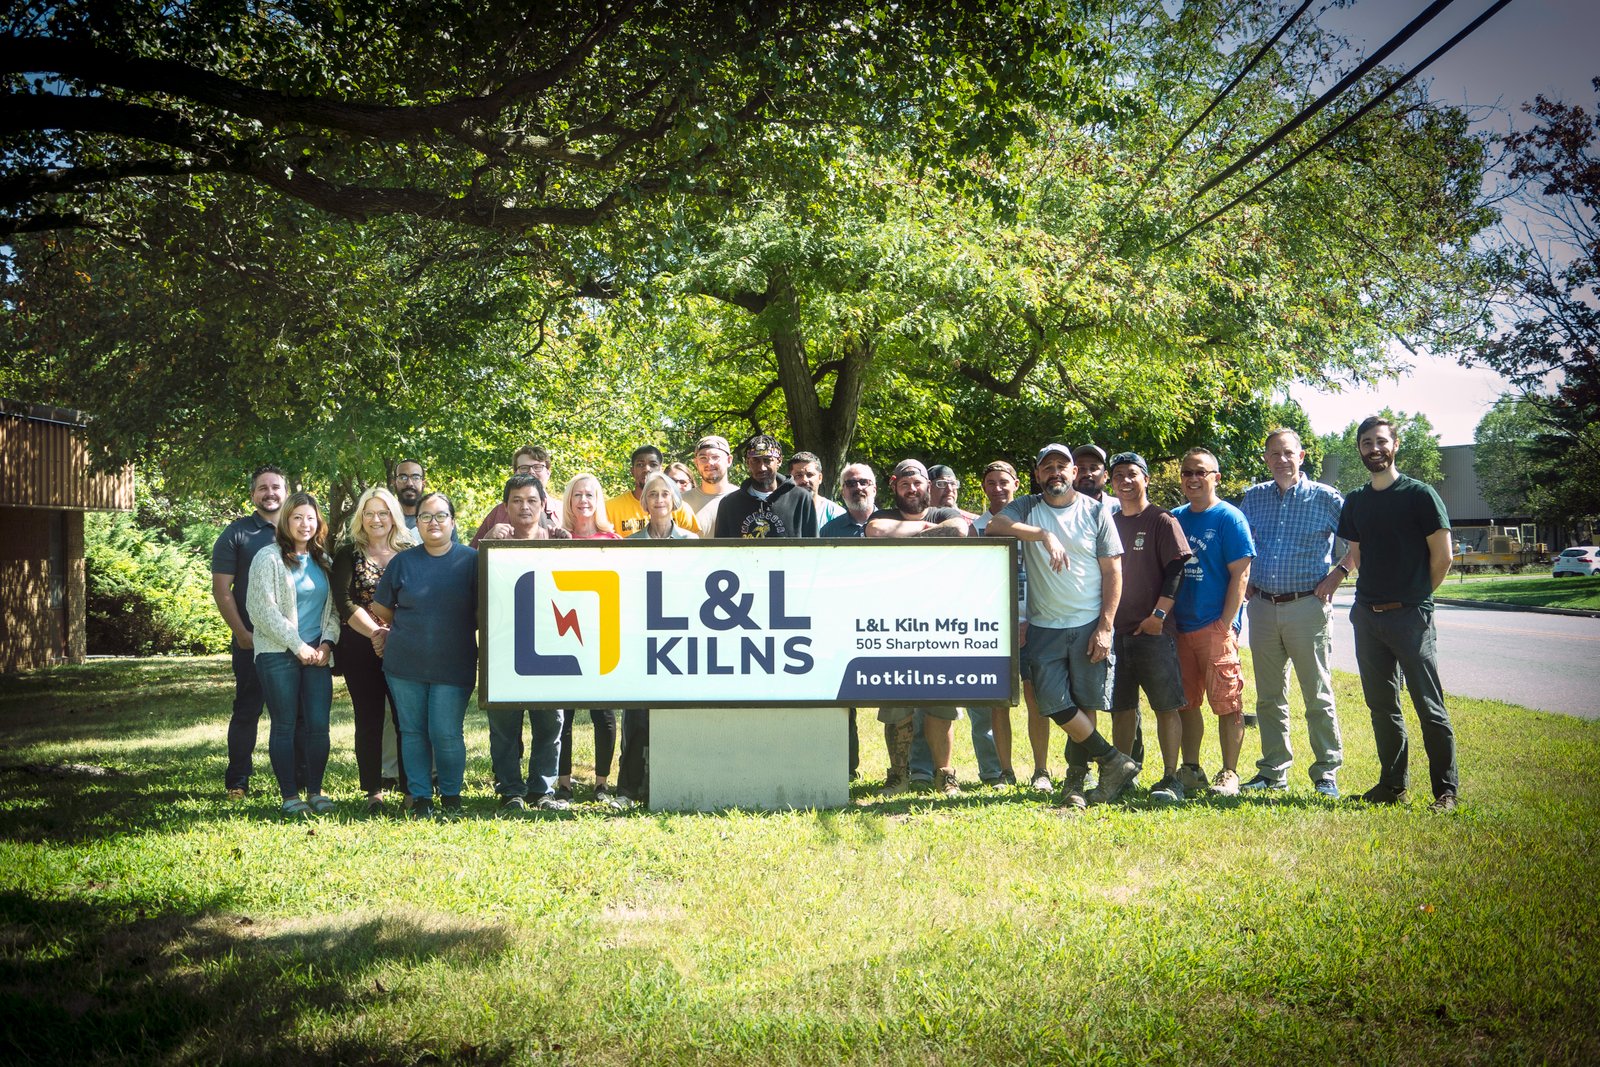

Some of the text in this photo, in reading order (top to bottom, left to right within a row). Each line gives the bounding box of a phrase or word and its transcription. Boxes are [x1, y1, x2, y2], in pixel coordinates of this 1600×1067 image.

[646, 569, 812, 631] L&L
[855, 618, 999, 635] L&L Kiln Mfg Inc
[856, 637, 998, 652] 505 Sharptown Road
[646, 635, 815, 676] KILNS
[856, 669, 998, 686] hotkilns.com
